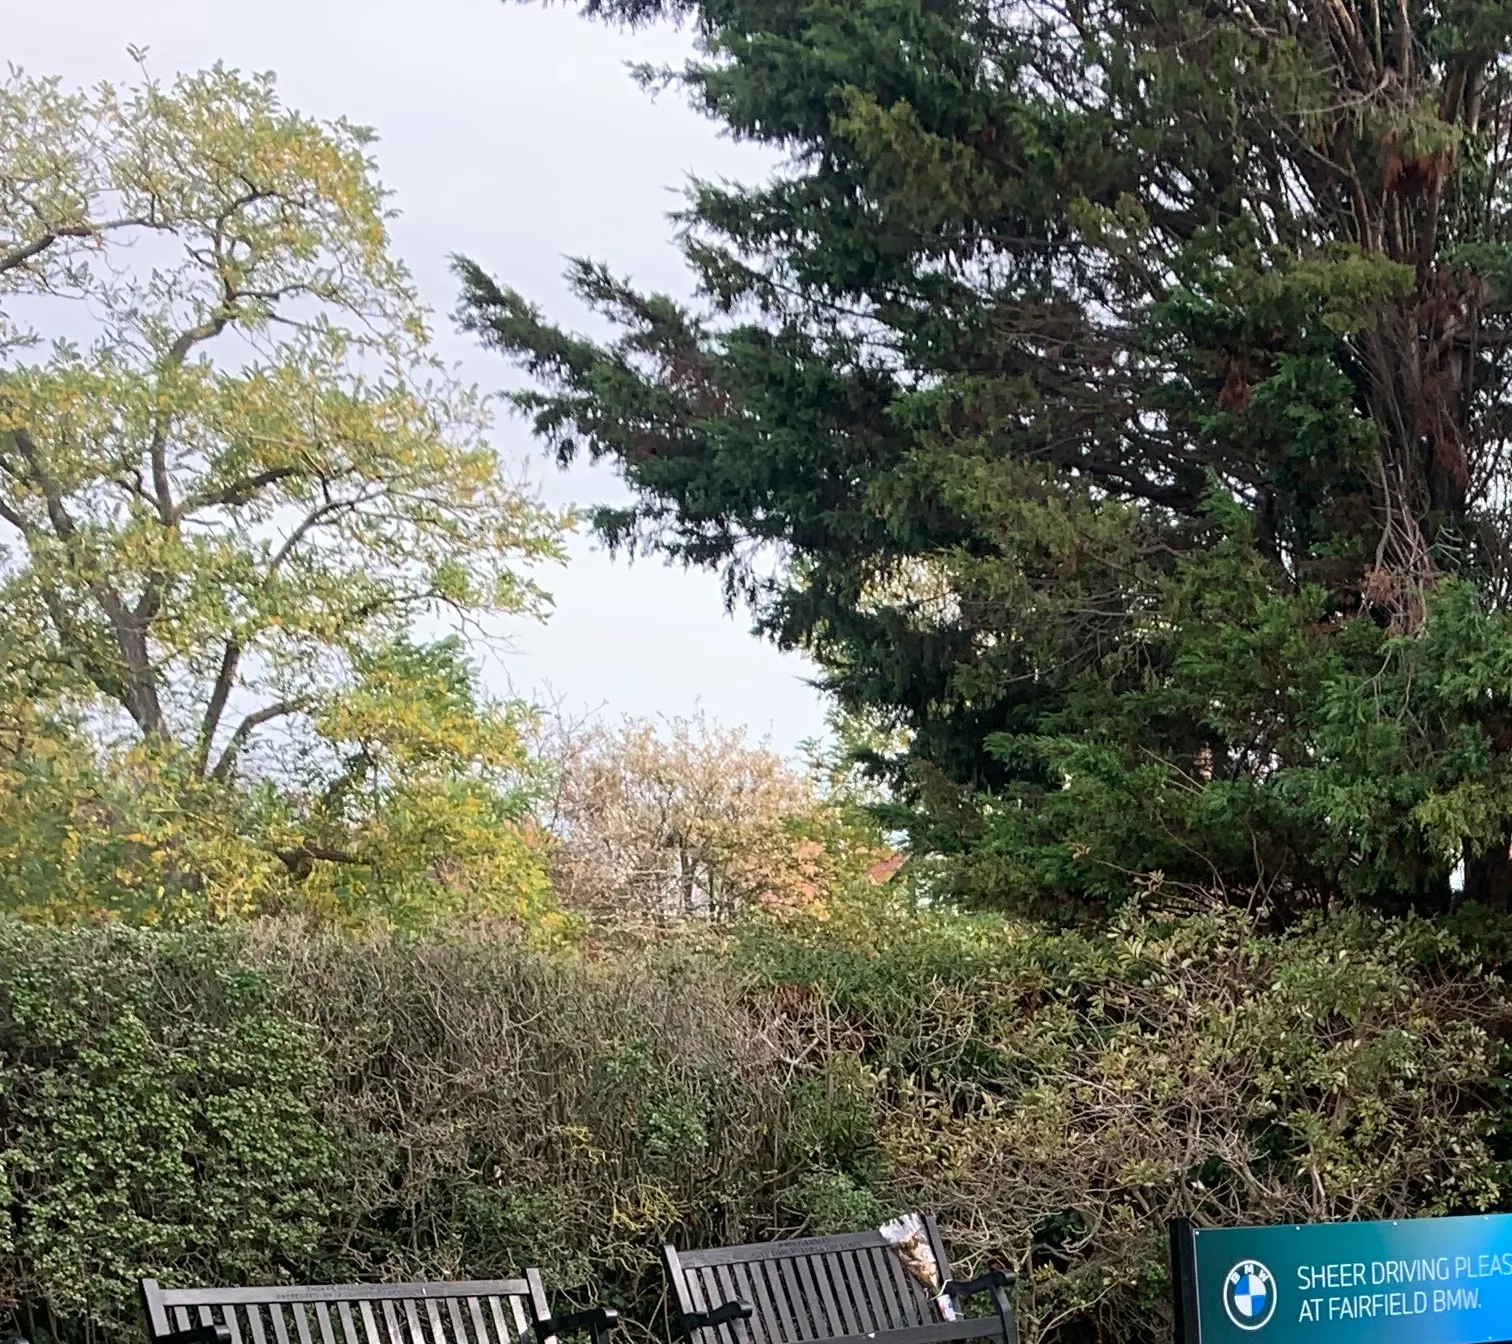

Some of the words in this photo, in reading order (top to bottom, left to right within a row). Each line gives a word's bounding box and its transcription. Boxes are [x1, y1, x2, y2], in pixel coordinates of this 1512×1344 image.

[1230, 1263, 1269, 1286] BMW
[1297, 1262, 1366, 1291] SHEER
[1371, 1257, 1450, 1285] DRIVING
[1298, 1298, 1324, 1324] AT
[1329, 1291, 1428, 1321] FAIRFIELD
[1433, 1287, 1482, 1313] BMW.
